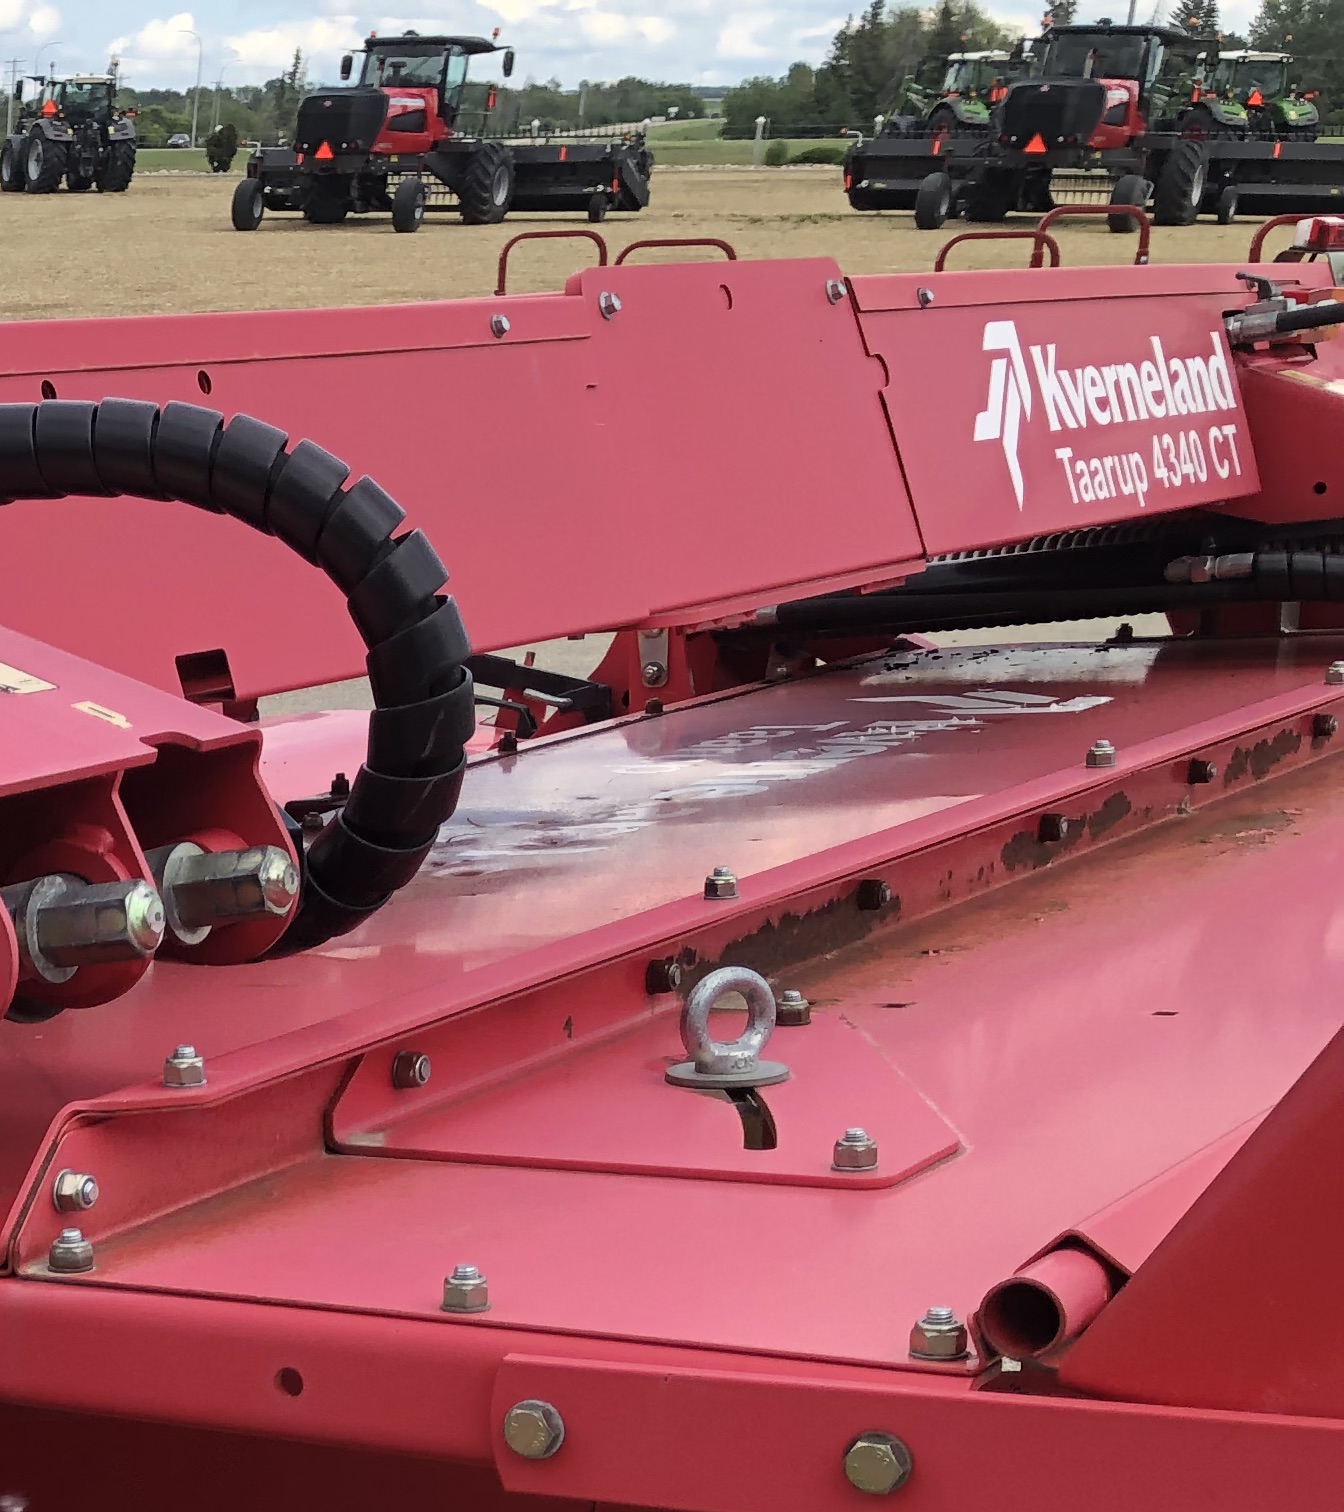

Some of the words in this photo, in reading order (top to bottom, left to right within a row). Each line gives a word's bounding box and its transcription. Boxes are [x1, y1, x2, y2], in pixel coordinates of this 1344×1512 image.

[1029, 330, 1237, 431] Kverneland
[1055, 447, 1148, 507] Taarup
[1152, 430, 1208, 488] 4340
[1211, 424, 1242, 479] CT
